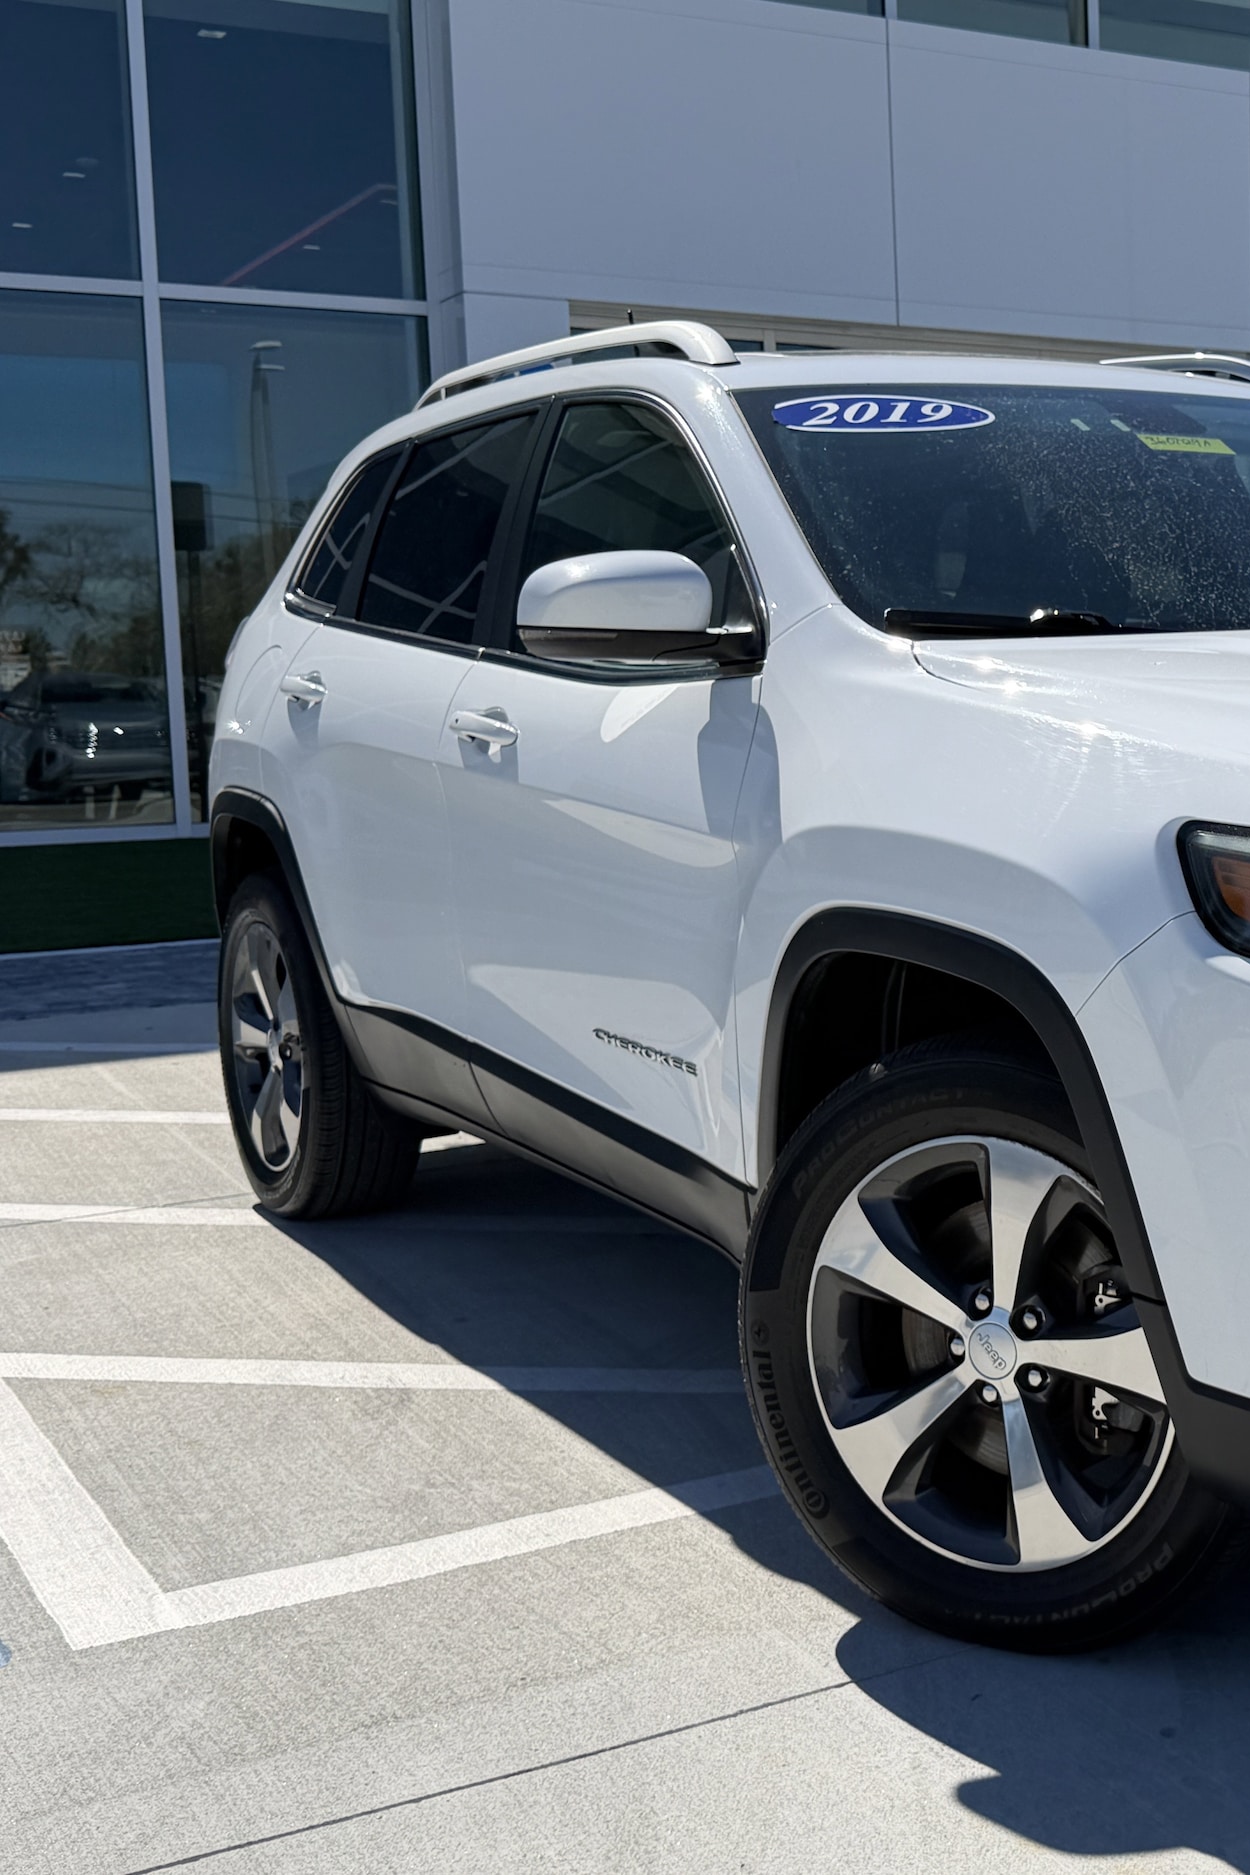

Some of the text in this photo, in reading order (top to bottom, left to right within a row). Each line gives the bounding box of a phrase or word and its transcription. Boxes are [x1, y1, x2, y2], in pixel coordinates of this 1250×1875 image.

[802, 401, 952, 426] 2019
[592, 1028, 698, 1077] CHEROKEE
[977, 1332, 1007, 1371] Jeep
[752, 1349, 831, 1520] Continental
